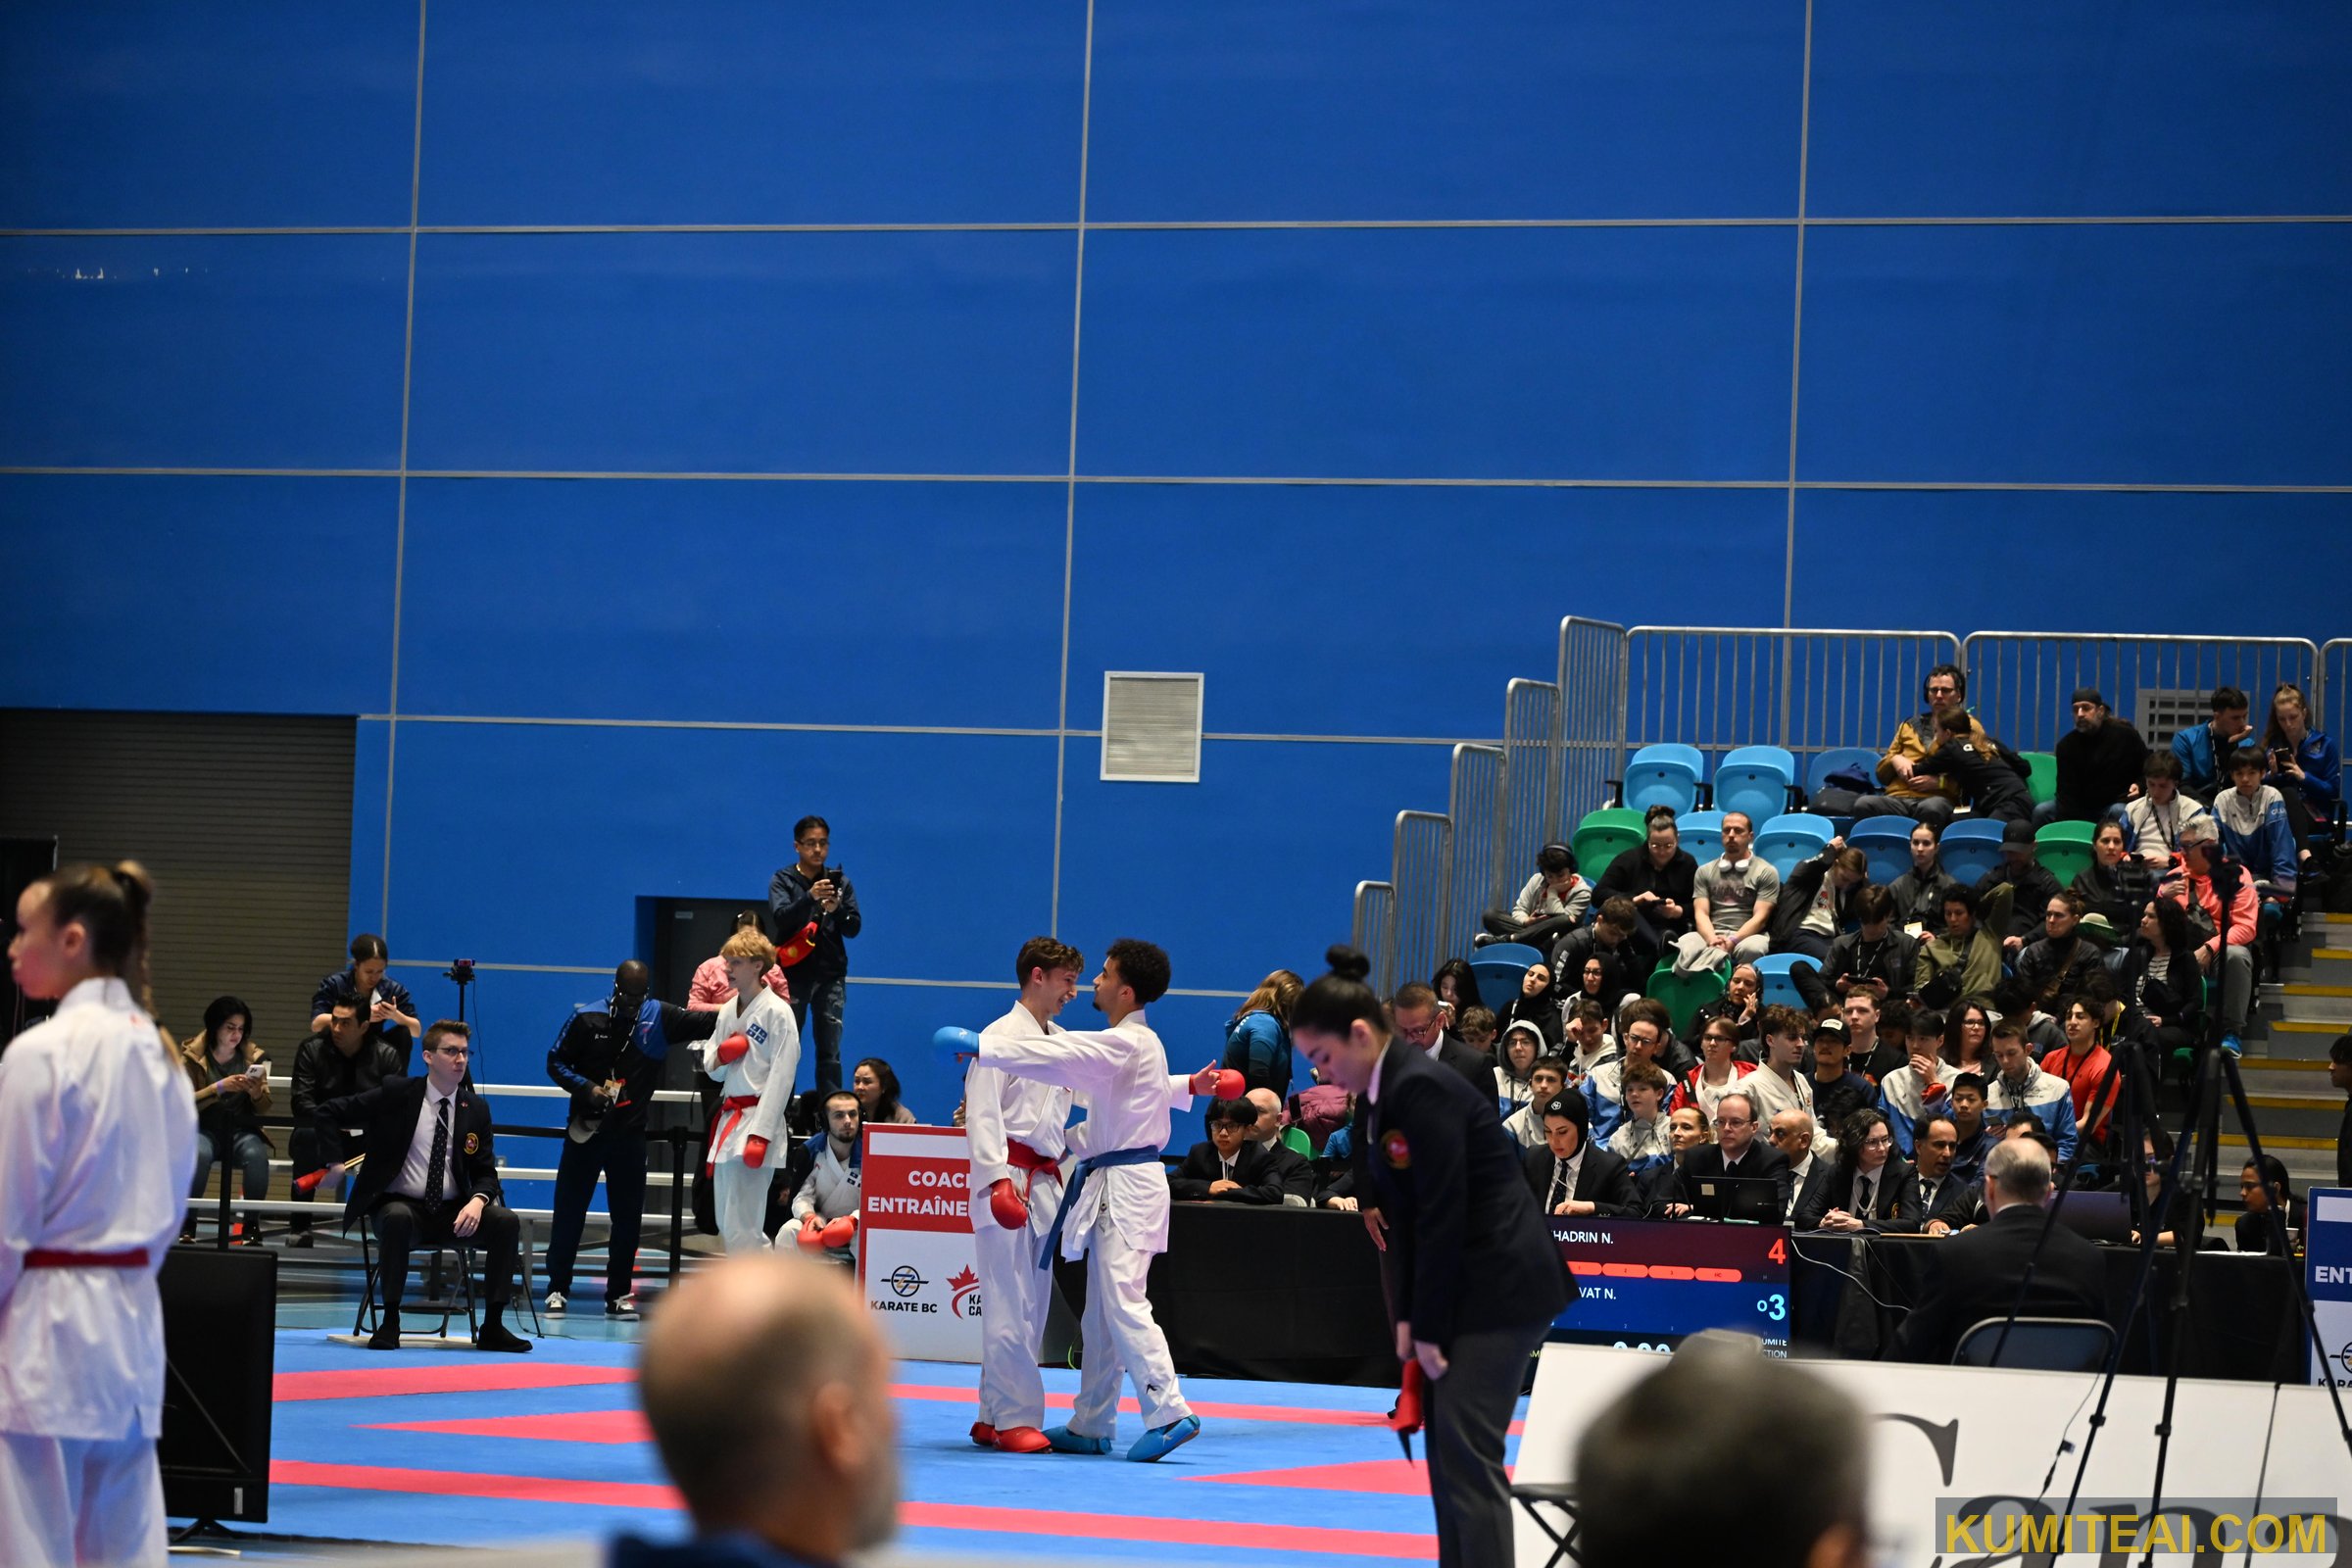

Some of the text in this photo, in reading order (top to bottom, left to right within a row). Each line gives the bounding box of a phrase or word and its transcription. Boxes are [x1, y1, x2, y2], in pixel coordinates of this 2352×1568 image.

[867, 1196, 968, 1217] ENTRAÎNE
[1551, 1230, 1614, 1245] HADRIN N.
[1768, 1238, 1787, 1264] 4
[1578, 1287, 1617, 1299] VAT N.
[870, 1300, 938, 1313] KARATE BC
